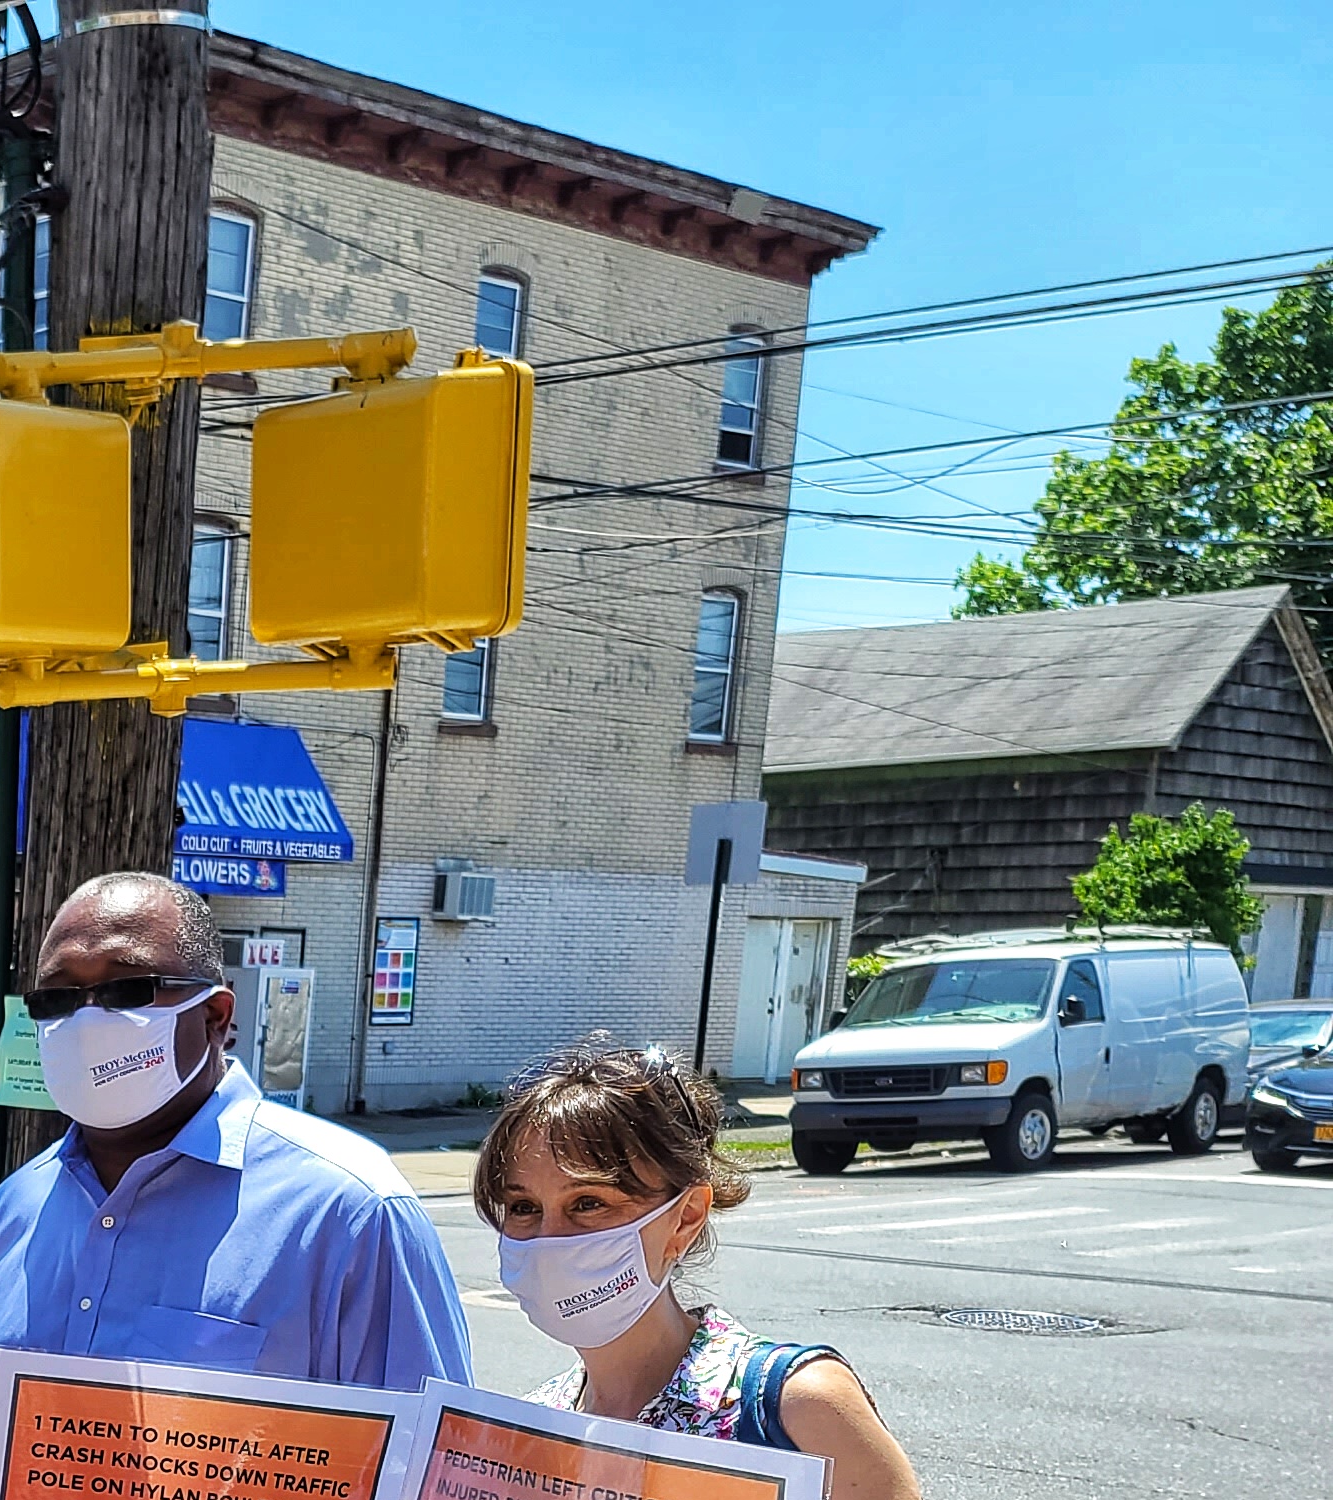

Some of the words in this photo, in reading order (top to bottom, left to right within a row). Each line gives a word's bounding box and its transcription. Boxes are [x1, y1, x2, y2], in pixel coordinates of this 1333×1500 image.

[210, 789, 240, 827] &
[228, 784, 339, 833] GROCERY
[181, 834, 209, 851] COLD
[209, 836, 230, 853] CUT
[240, 839, 274, 856] FRUITS
[274, 841, 282, 856] &
[283, 841, 342, 860] VEGETABLES
[172, 857, 251, 886] FLOWERS
[246, 942, 281, 966] ICE
[614, 1275, 640, 1296] 2021
[34, 1415, 43, 1431] 1
[49, 1417, 123, 1440] TAKEN
[130, 1424, 158, 1443] TO
[165, 1429, 262, 1457] HOSPITAL
[268, 1443, 331, 1467] AFTER
[27, 1469, 84, 1492] POLE
[90, 1476, 124, 1497] ON
[31, 1442, 104, 1465] CRASH
[111, 1451, 199, 1478] KNOCKS
[205, 1462, 269, 1488] DOWN
[273, 1473, 351, 1499] TRAFFIC
[443, 1448, 538, 1489] PEDESTRIAN
[540, 1473, 587, 1500] LEFT
